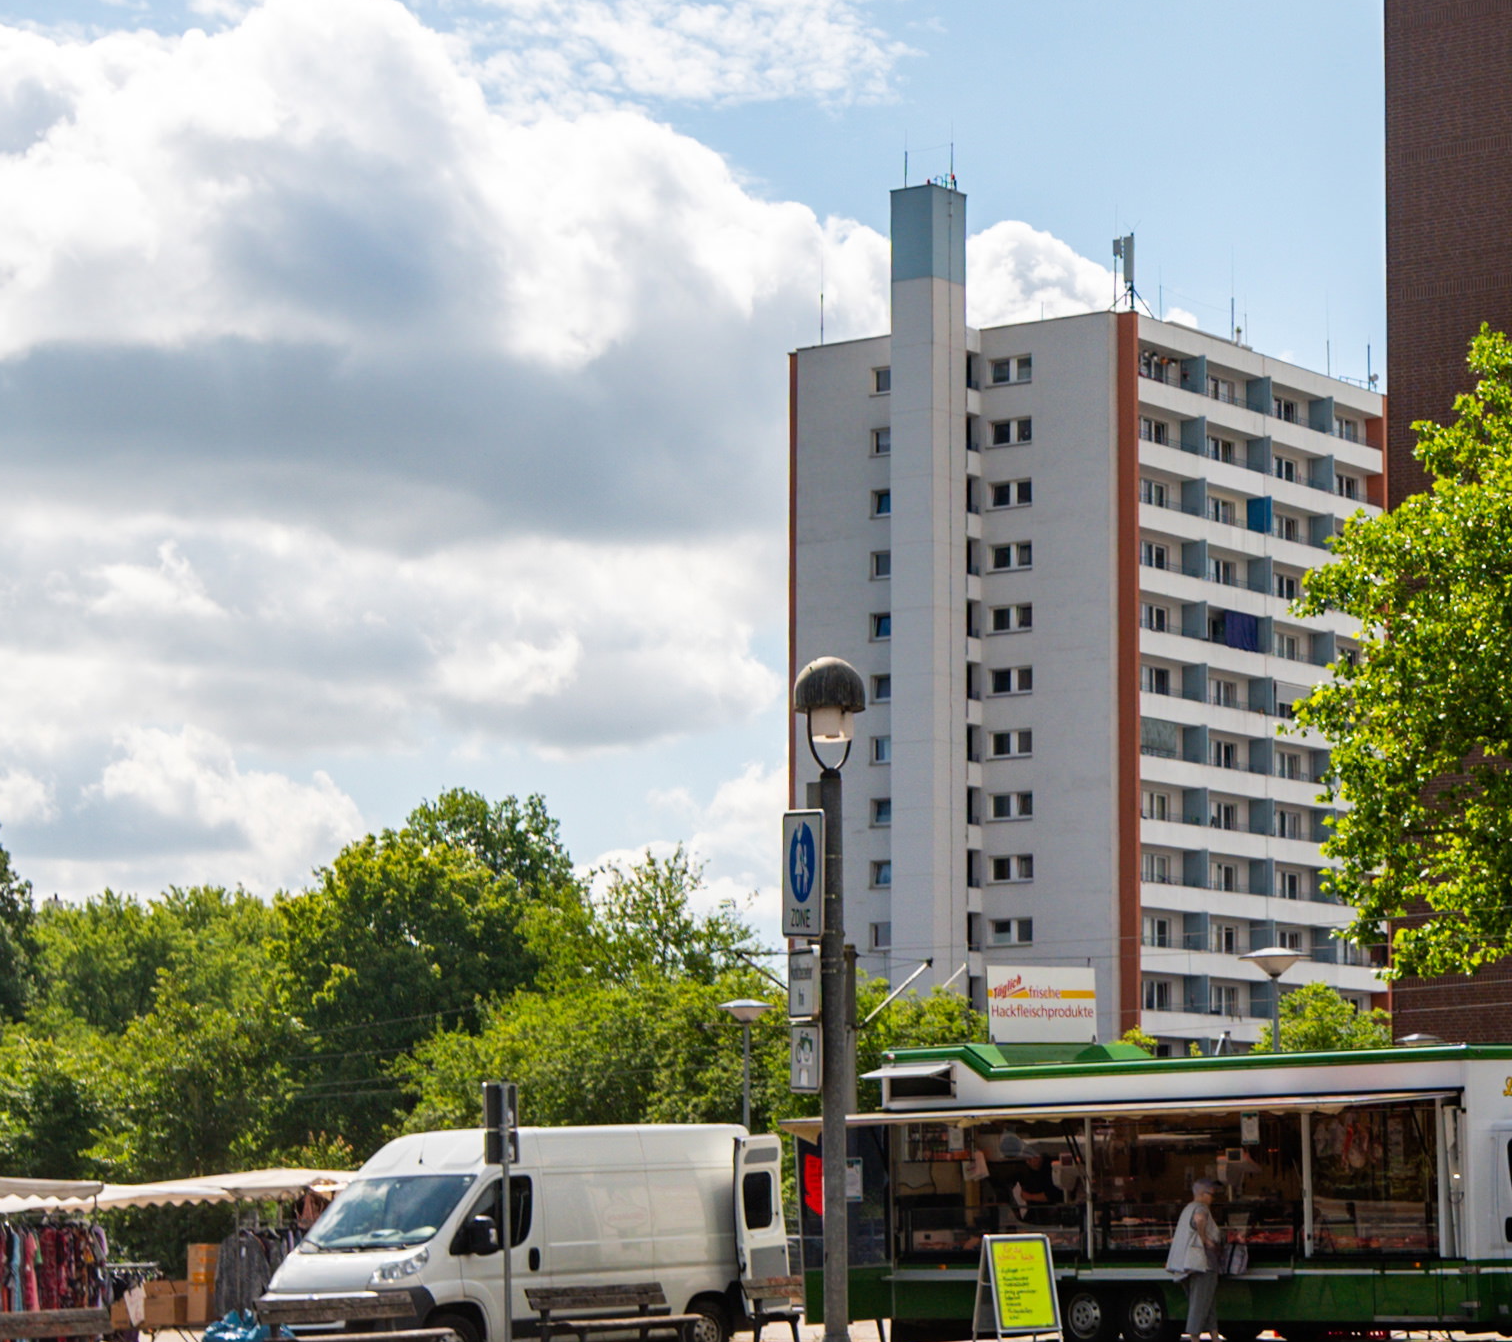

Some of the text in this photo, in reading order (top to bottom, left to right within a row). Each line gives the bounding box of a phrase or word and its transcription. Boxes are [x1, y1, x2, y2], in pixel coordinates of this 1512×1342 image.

[791, 908, 811, 929] ZONE
[993, 974, 1061, 999] Täglich frische
[991, 1004, 1094, 1021] Hackfleischprodukte
